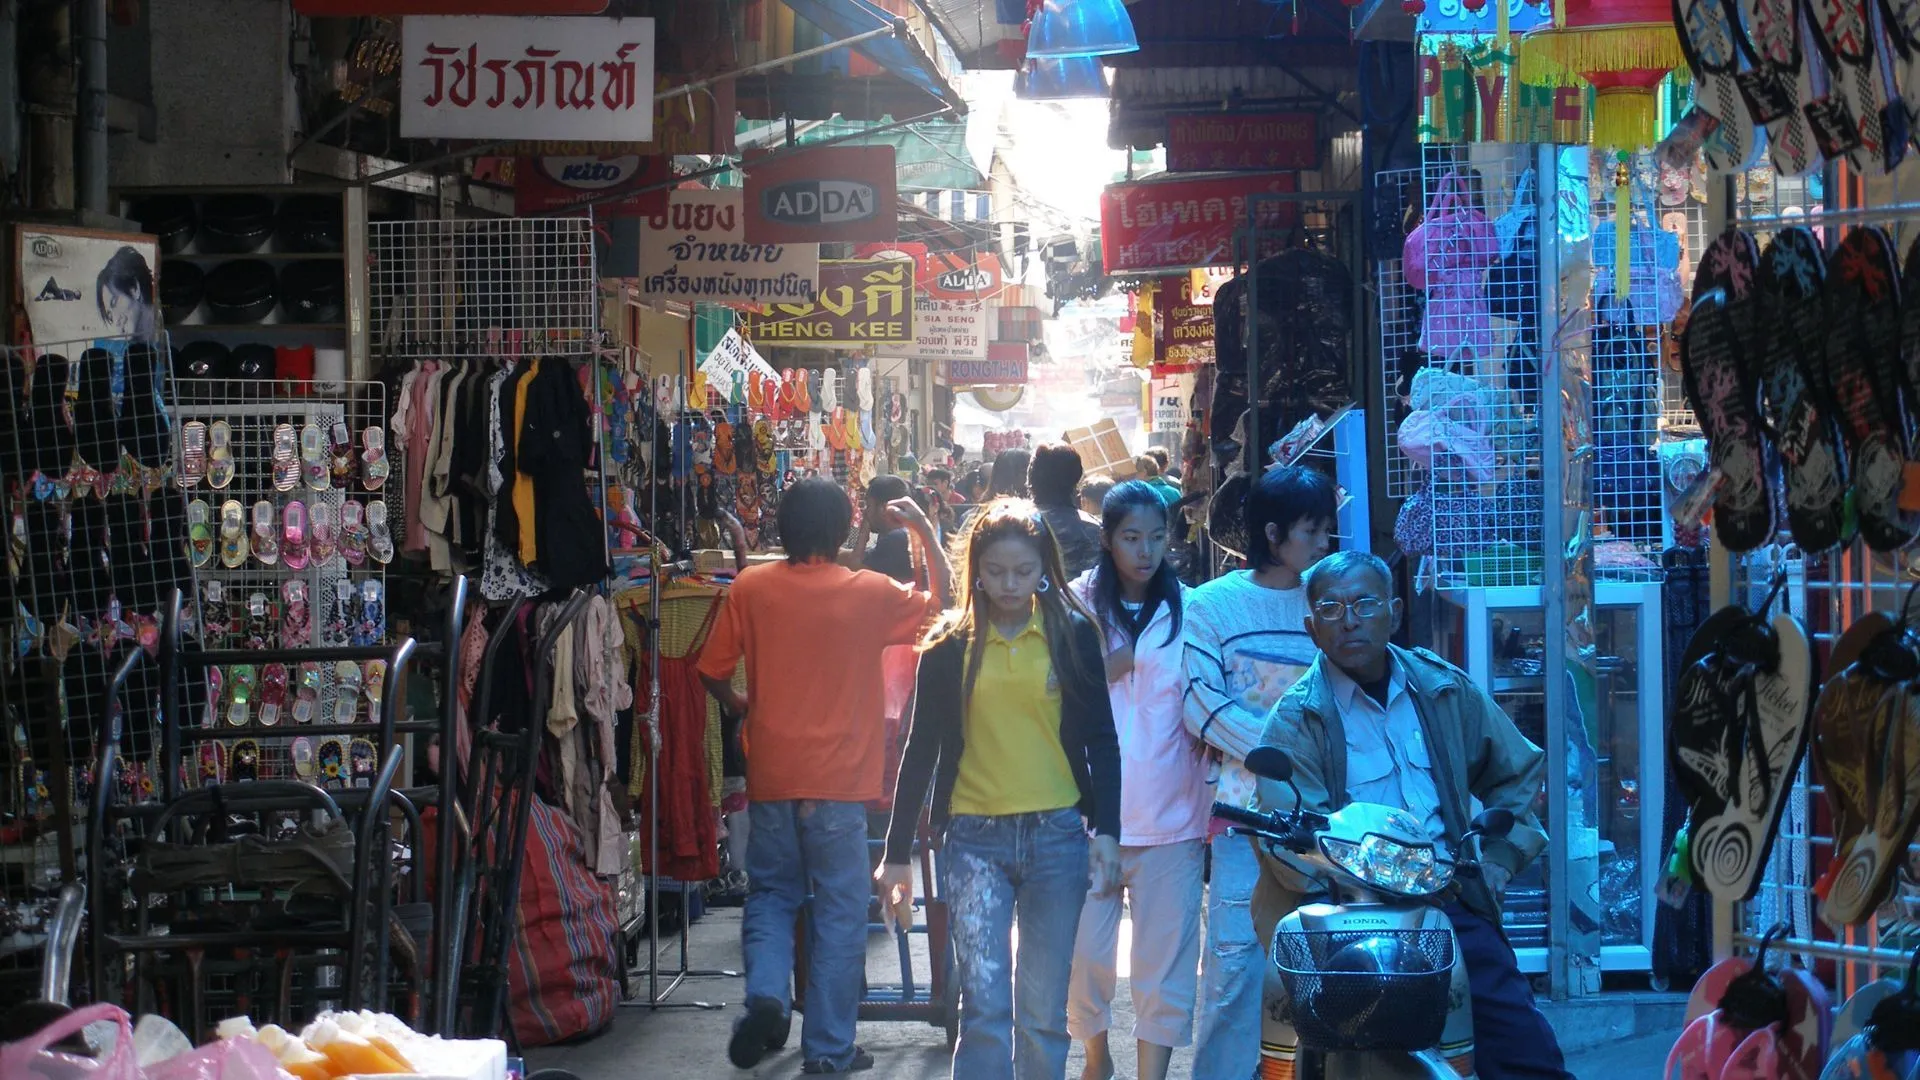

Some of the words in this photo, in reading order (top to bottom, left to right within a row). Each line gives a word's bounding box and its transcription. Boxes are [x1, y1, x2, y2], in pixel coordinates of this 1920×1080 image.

[562, 162, 621, 181] Kito
[774, 191, 866, 216] ADDA
[760, 322, 833, 337] HENG
[850, 321, 903, 337] KEE
[915, 333, 948, 346] รองเท้า
[951, 360, 1024, 378] RONGTHAI
[1342, 918, 1389, 926] HONDA
